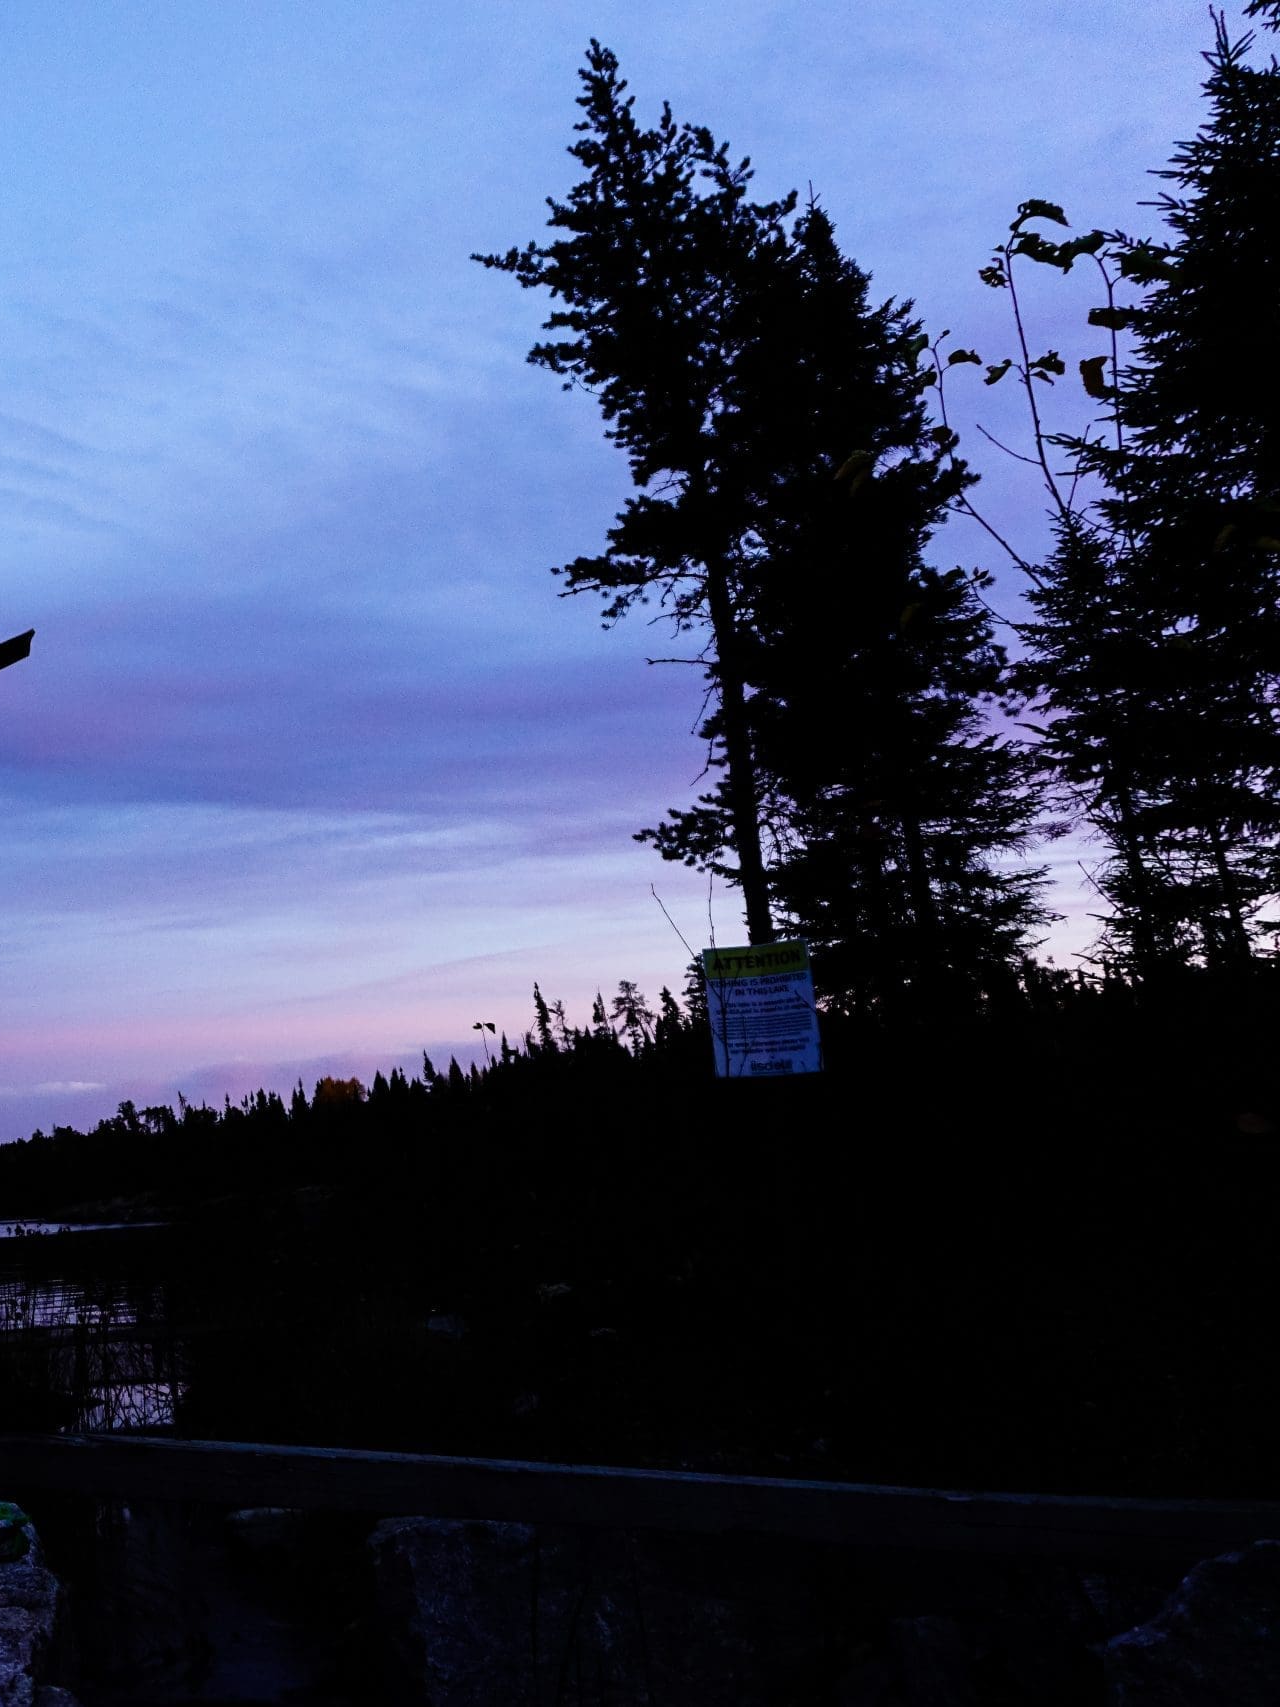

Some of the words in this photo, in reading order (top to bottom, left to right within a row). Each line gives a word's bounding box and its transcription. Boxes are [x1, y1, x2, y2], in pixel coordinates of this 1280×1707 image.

[713, 950, 801, 970] ATTENTION
[711, 977, 747, 987] FISHING
[750, 977, 759, 986] IS
[760, 972, 807, 985] PROHIBITED
[769, 984, 789, 993] LAKE
